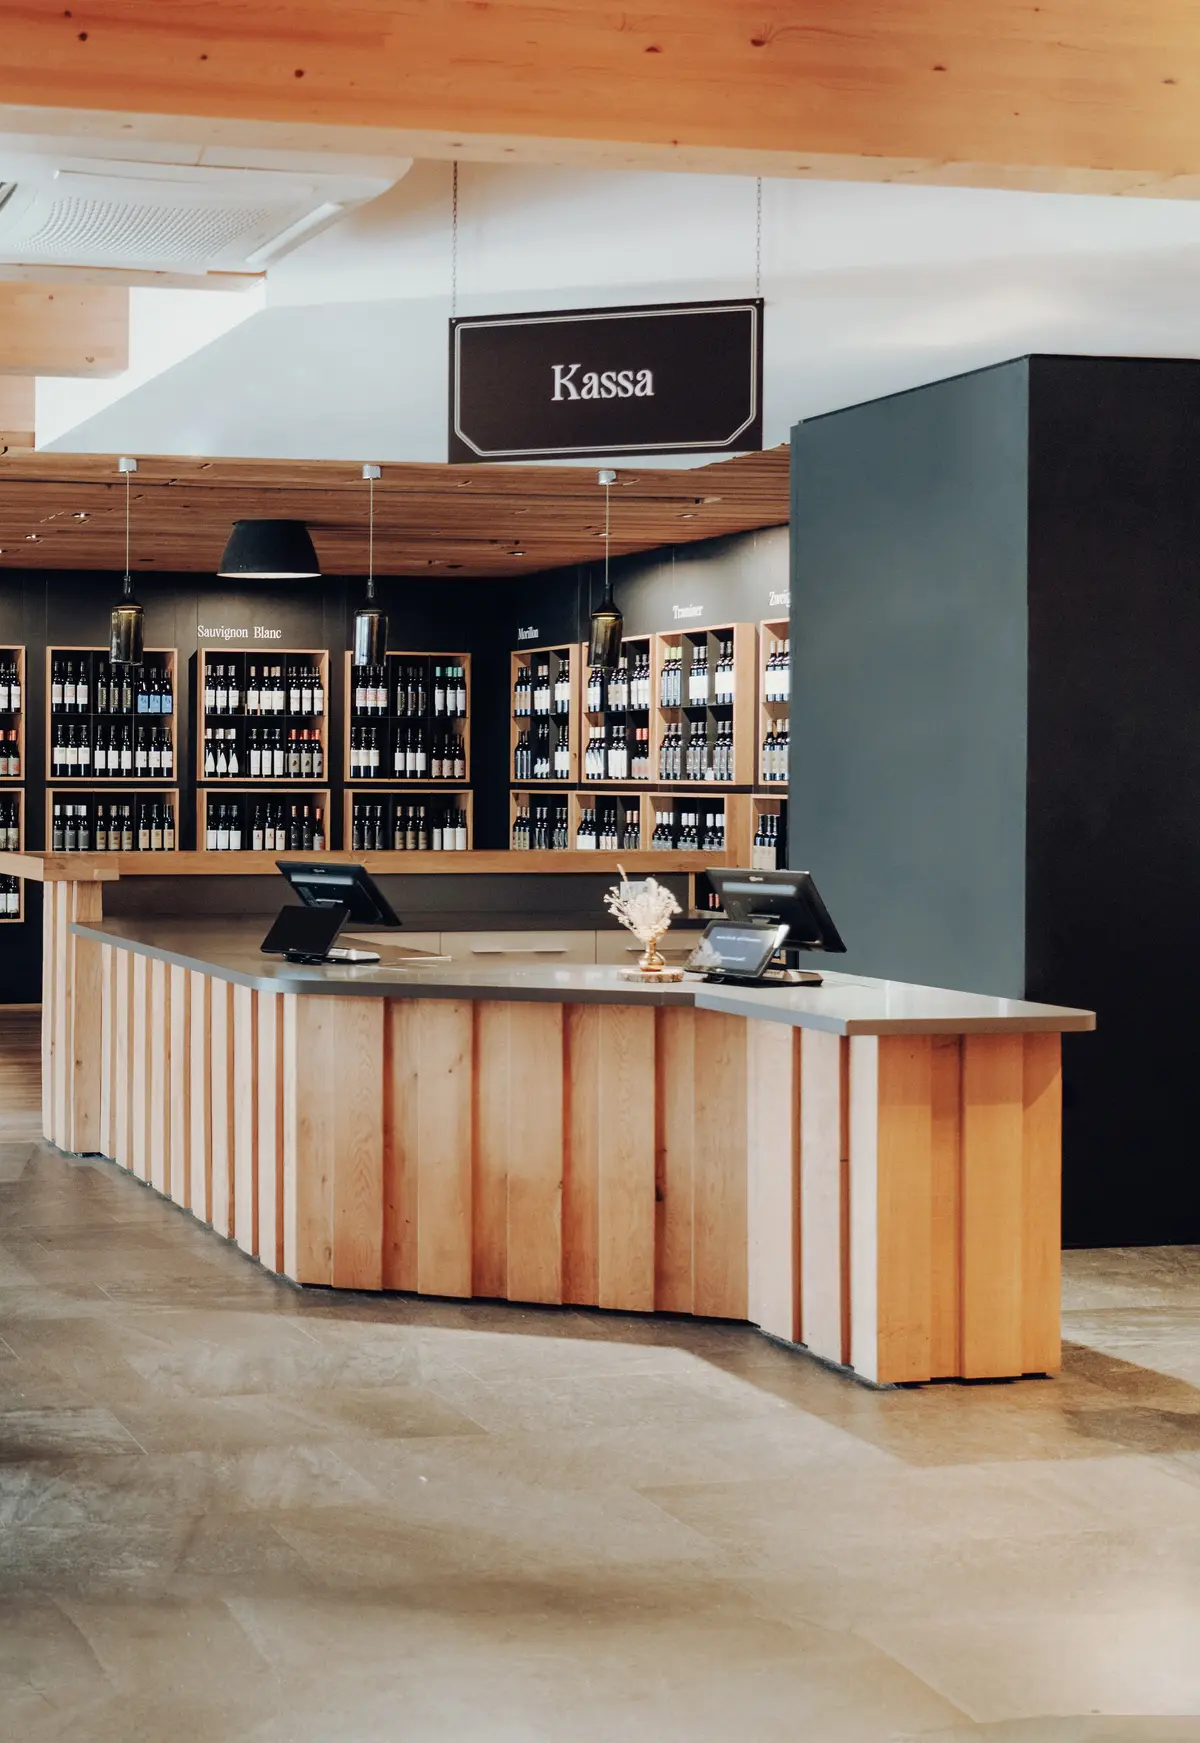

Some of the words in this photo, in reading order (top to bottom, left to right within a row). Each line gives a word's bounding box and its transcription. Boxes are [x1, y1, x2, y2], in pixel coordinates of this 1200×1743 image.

[550, 363, 655, 401] Kassa
[197, 625, 249, 640] Sauvignon
[253, 626, 282, 639] Blanc
